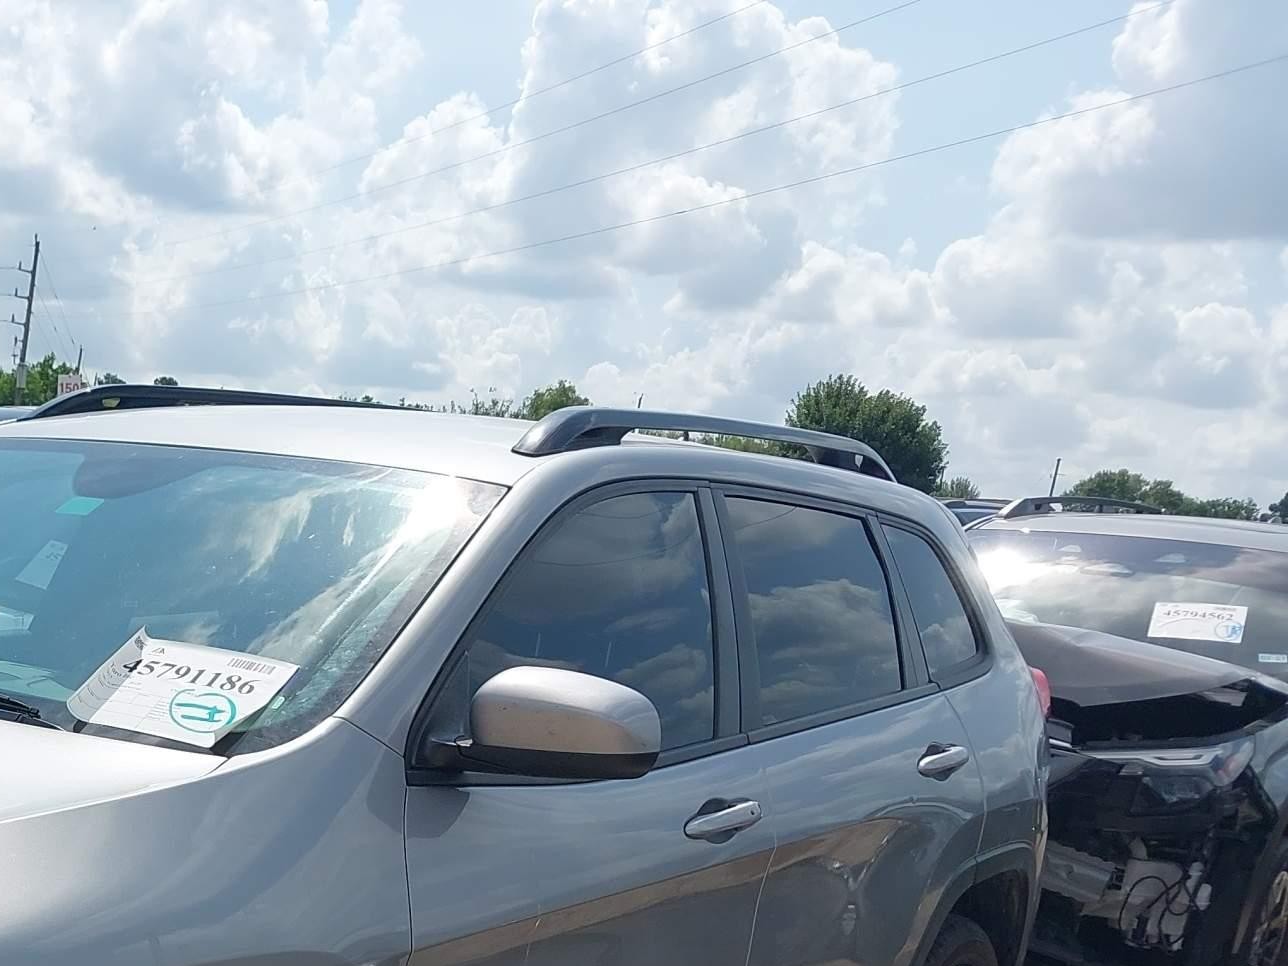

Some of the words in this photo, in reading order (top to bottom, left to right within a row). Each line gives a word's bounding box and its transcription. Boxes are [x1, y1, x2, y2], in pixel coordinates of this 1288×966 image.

[60, 383, 79, 393] 150
[1163, 609, 1234, 621] 45794562
[122, 658, 262, 695] 45791186
